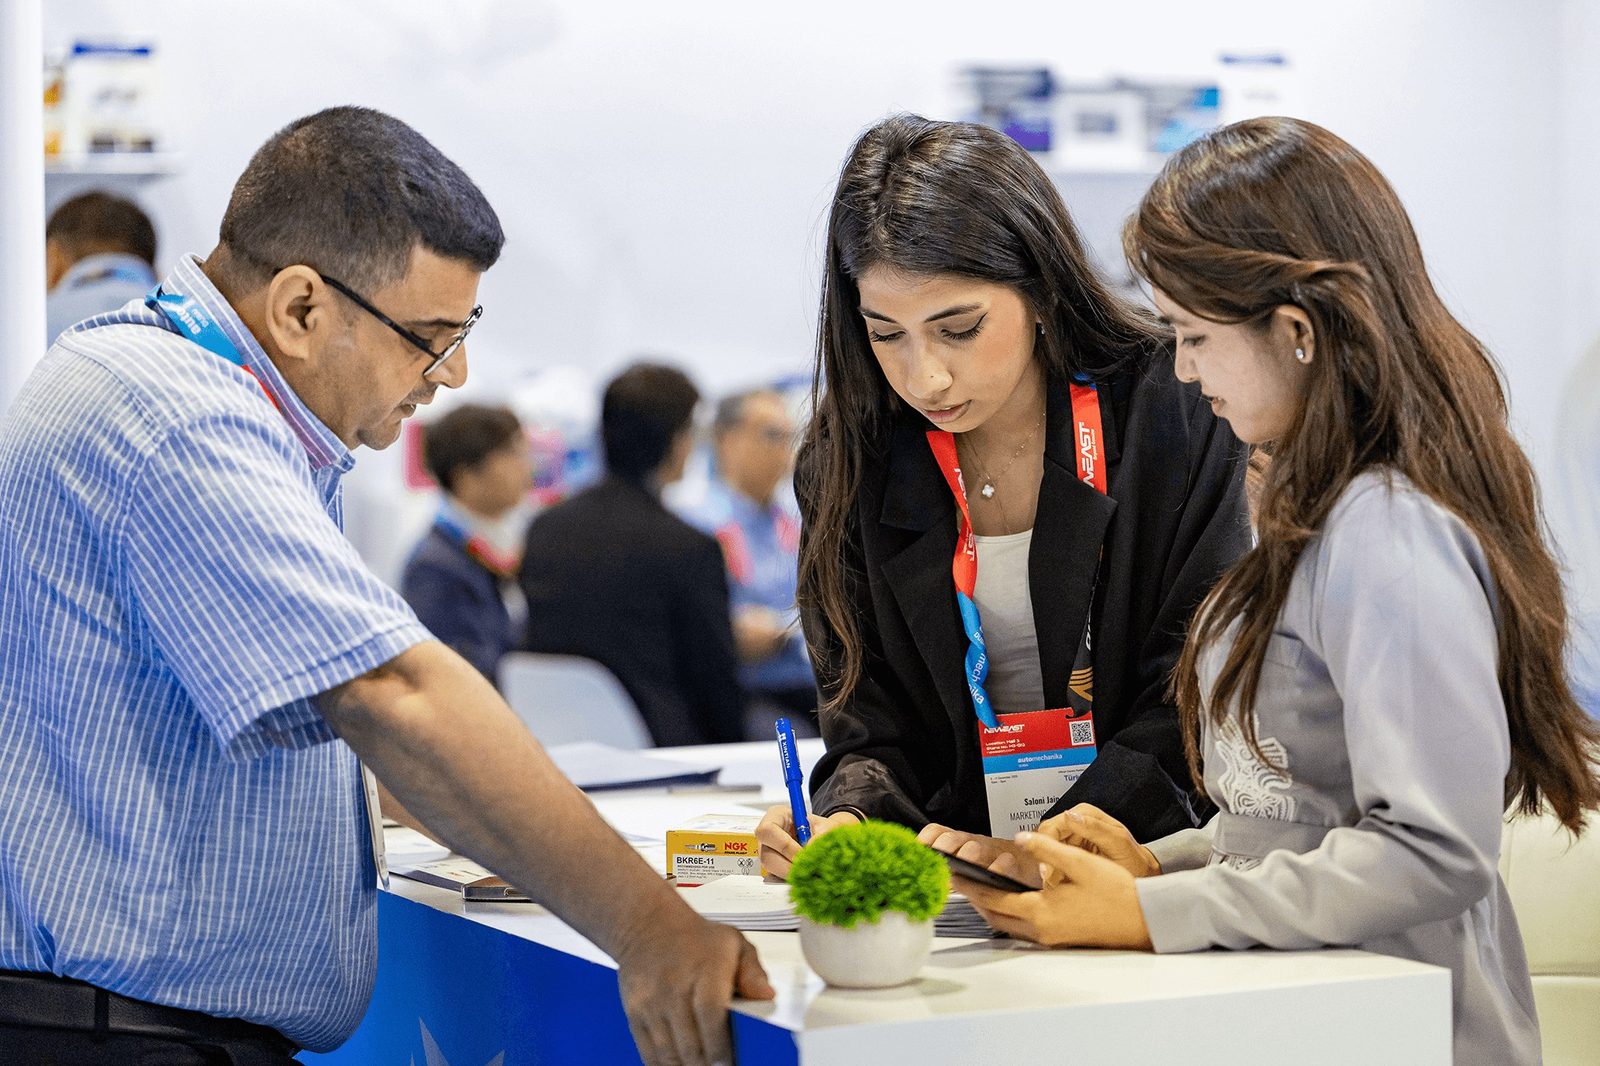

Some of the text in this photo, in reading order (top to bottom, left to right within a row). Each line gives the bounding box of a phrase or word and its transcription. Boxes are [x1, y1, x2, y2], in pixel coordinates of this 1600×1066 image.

[1018, 753, 1063, 763] automechanika
[1024, 797, 1045, 806] Saloni
[725, 842, 748, 851] NGK
[676, 857, 714, 865] BKR6E-11
